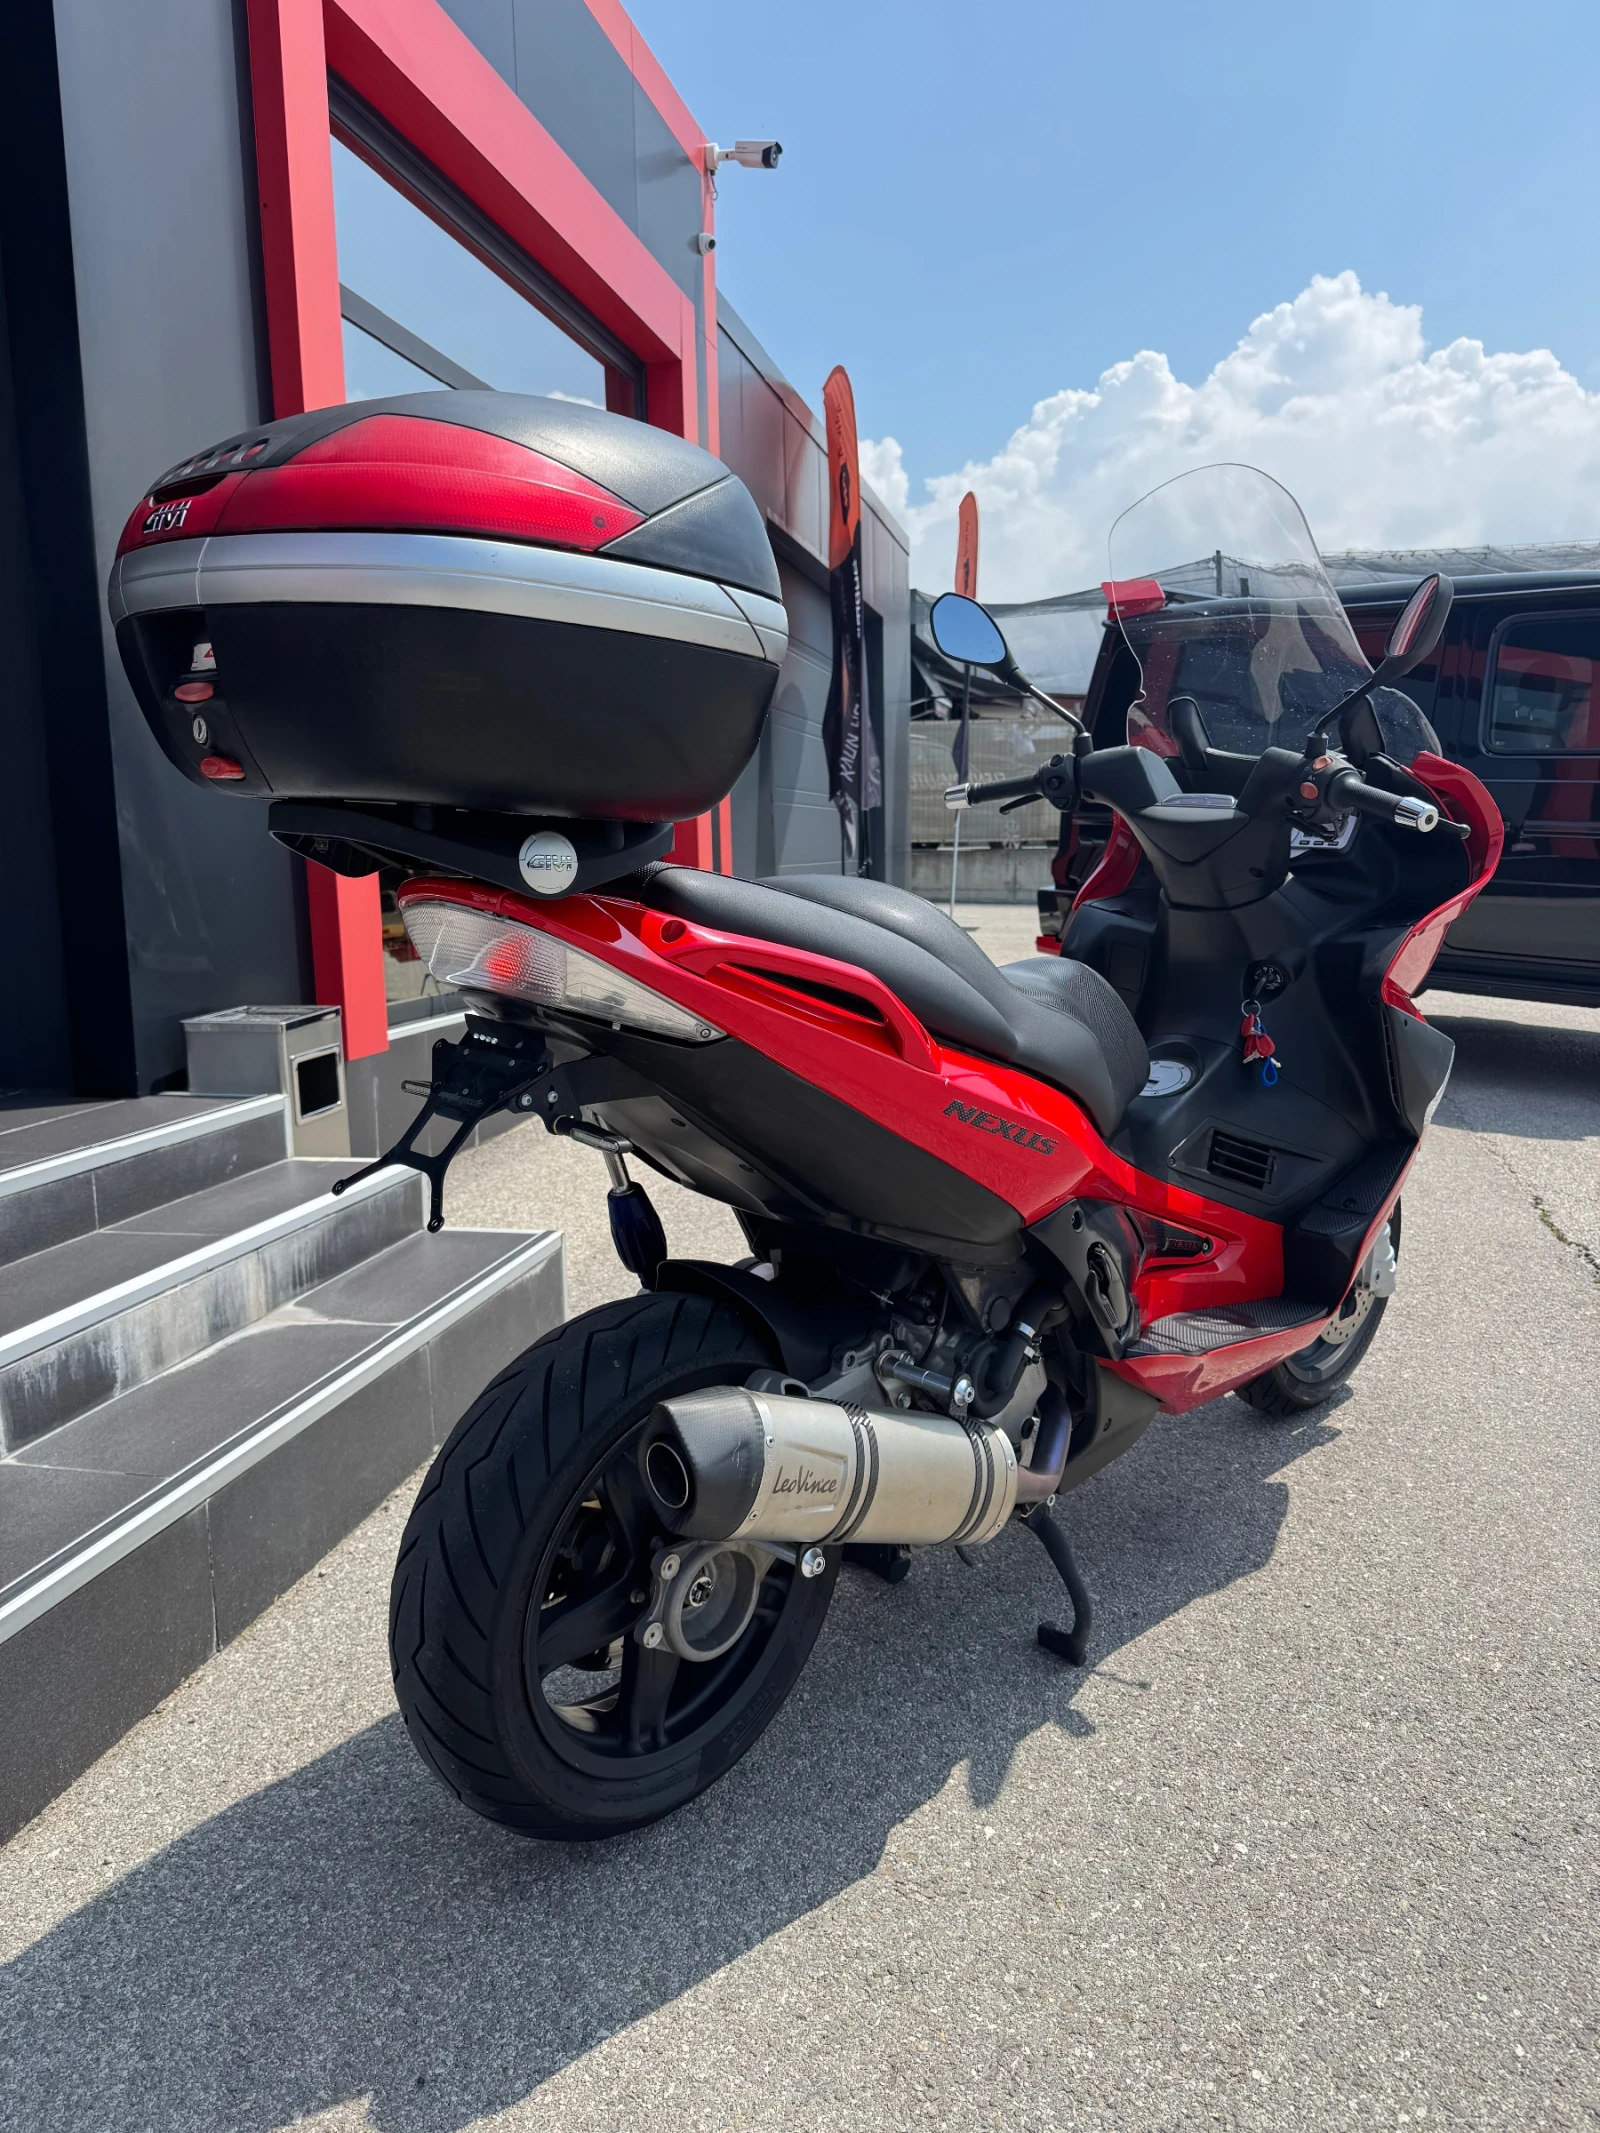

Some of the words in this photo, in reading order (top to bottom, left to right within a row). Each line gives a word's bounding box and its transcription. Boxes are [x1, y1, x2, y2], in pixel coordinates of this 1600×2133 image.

[142, 499, 192, 534] GIVI
[526, 854, 573, 873] GIVI
[942, 1098, 1060, 1156] NEXUS
[1167, 1238, 1202, 1251] NEXUS
[771, 1464, 837, 1495] LeoVince
